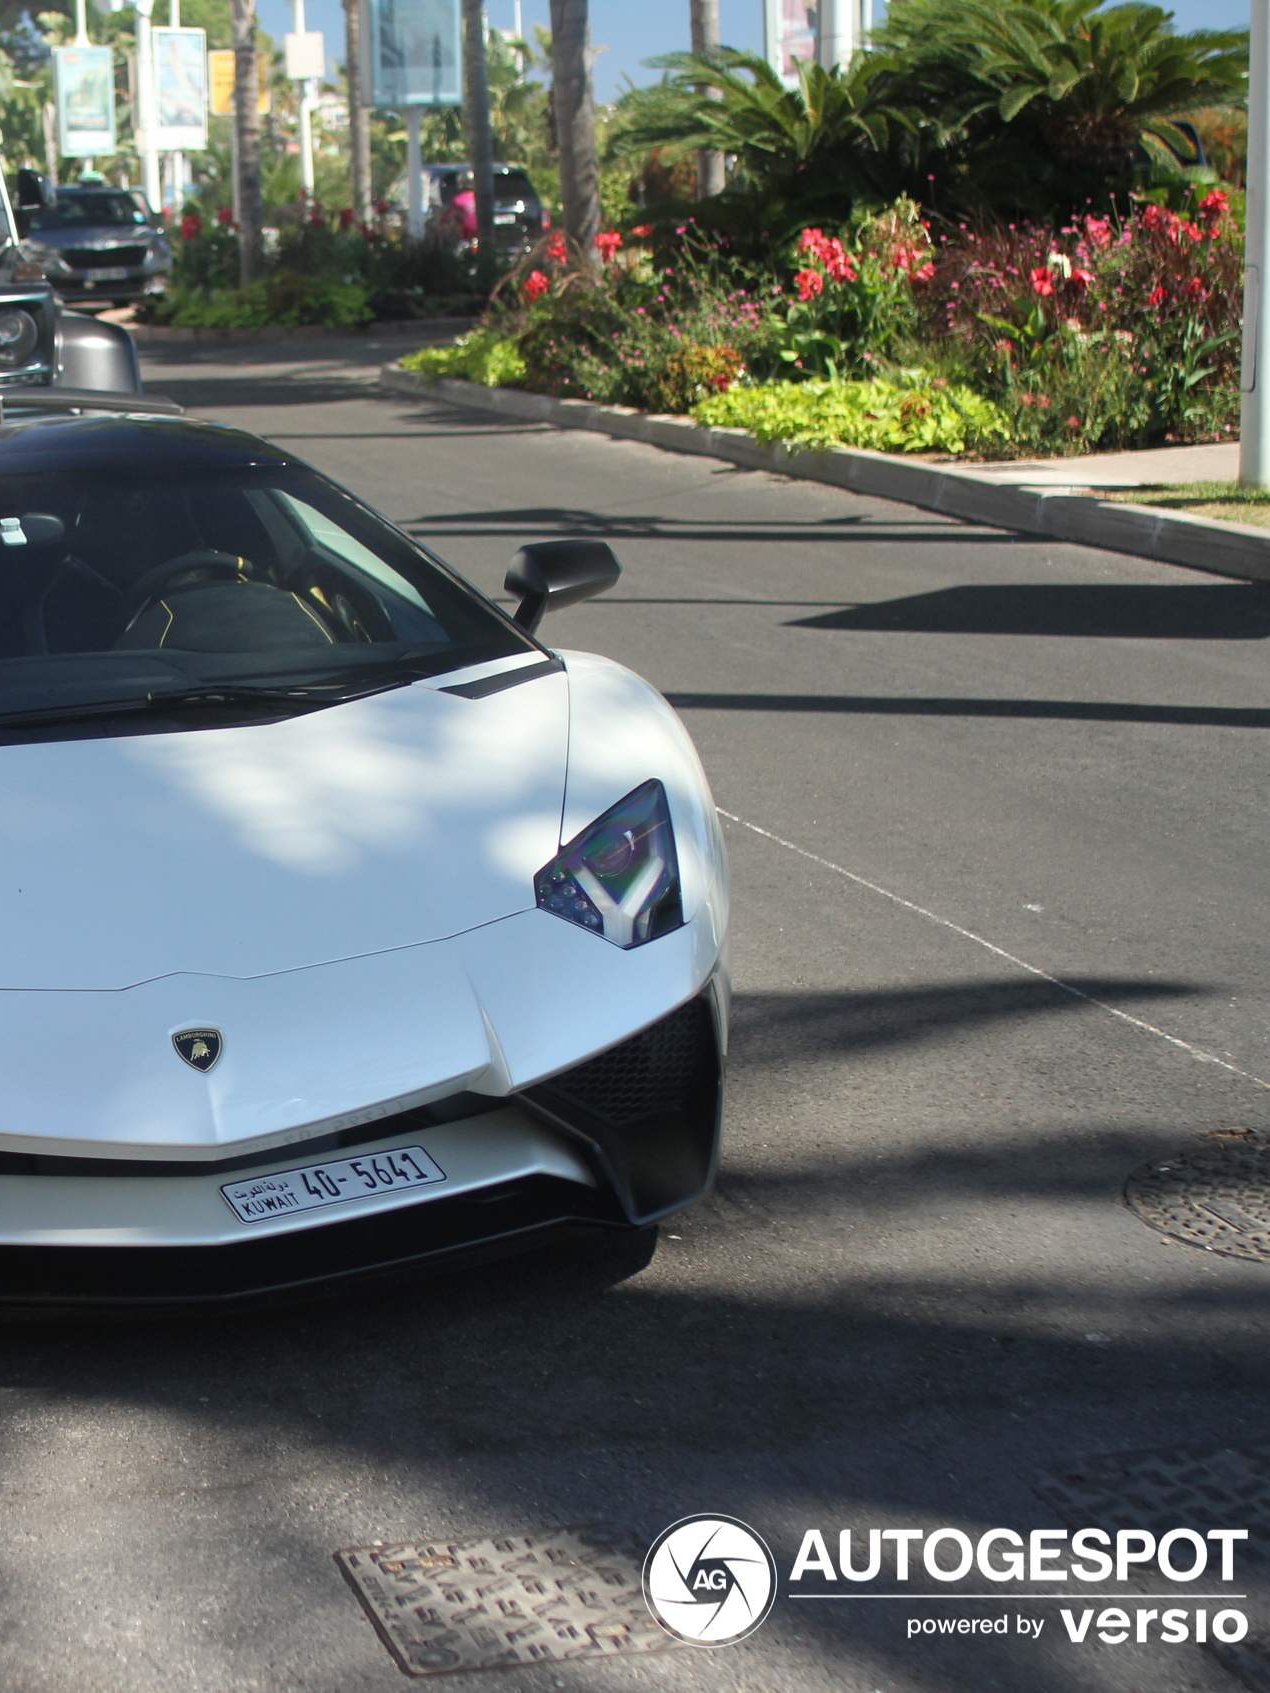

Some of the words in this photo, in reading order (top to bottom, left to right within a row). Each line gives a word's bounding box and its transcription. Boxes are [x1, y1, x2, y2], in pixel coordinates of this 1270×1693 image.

[176, 1032, 216, 1042] LAMBORGHINI
[301, 1152, 428, 1199] 40-5641
[241, 1192, 300, 1216] KUWAIT
